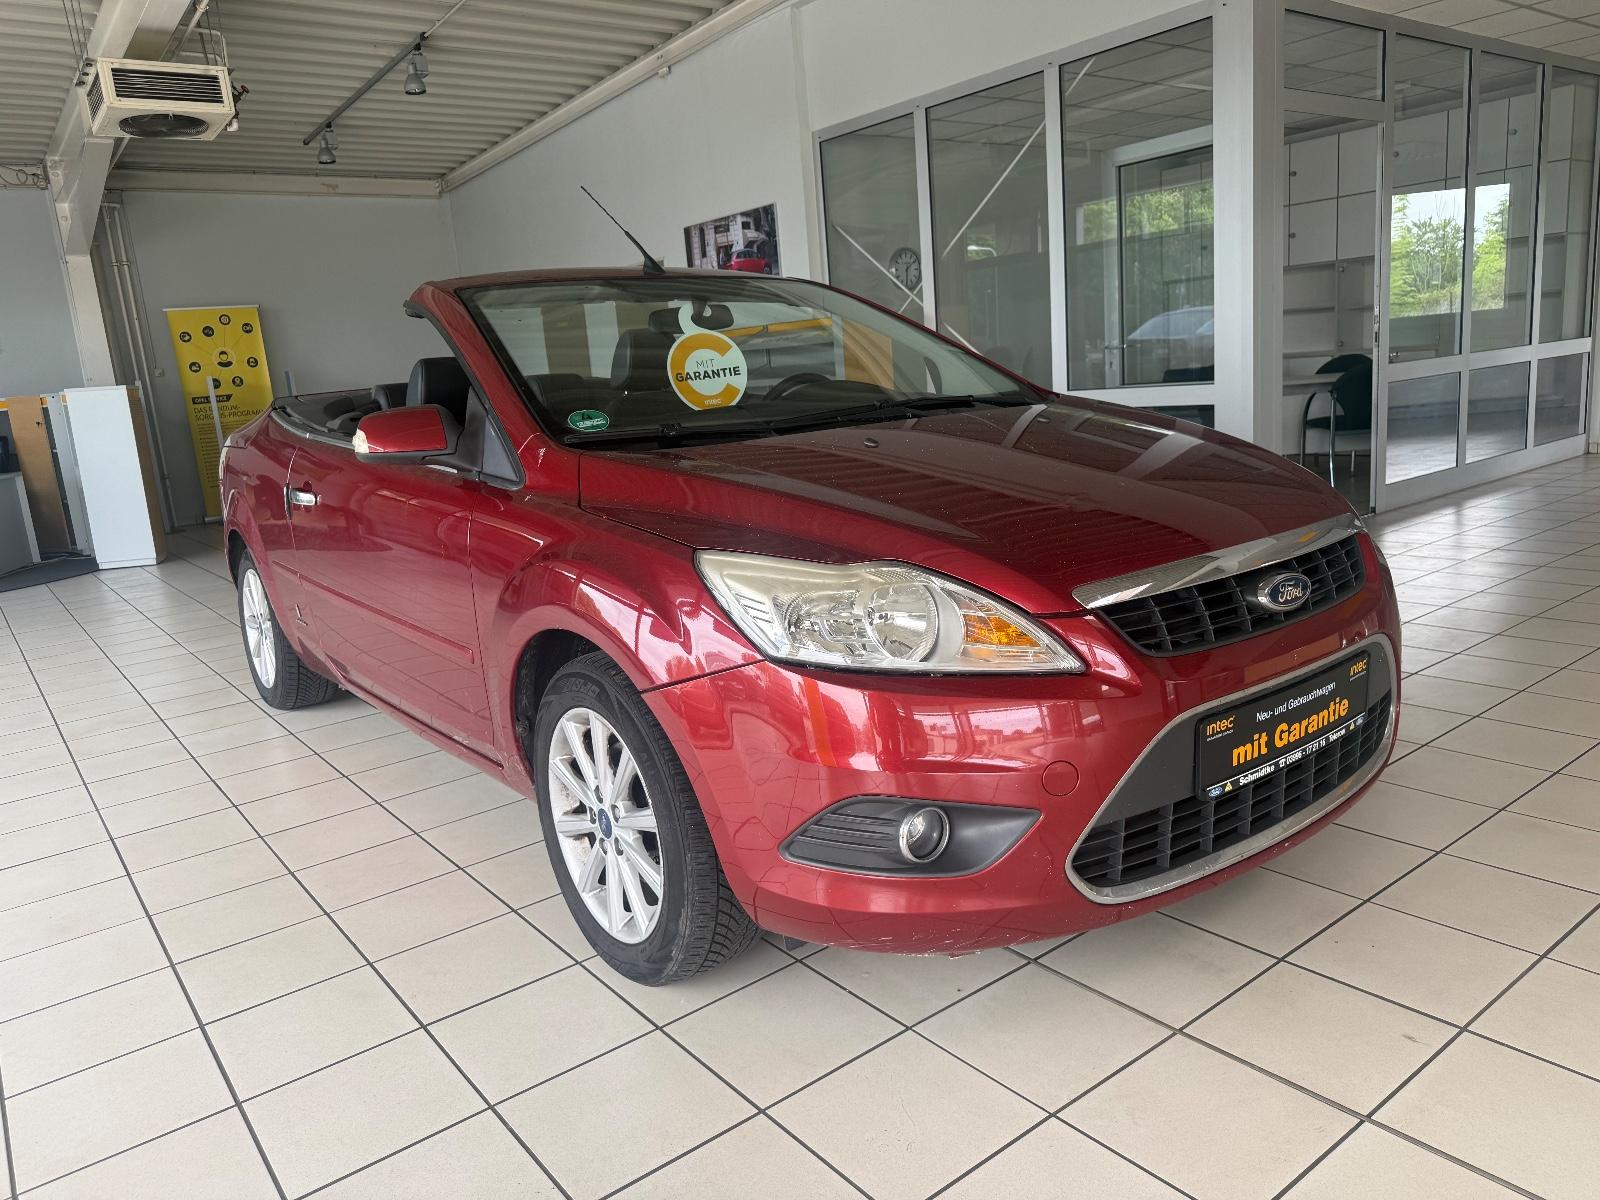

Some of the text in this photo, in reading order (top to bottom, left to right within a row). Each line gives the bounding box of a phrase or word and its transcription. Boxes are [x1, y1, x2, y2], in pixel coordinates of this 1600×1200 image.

[675, 366, 741, 382] GARANTIE
[696, 359, 714, 369] MIT
[194, 406, 208, 414] DAS
[1278, 581, 1304, 603] Ford
[1256, 681, 1336, 723] Neu- und Gebrauchtwagen
[1206, 715, 1236, 736] intec
[1232, 697, 1349, 767] mit Garantie
[1239, 765, 1275, 786] Schmidtke
